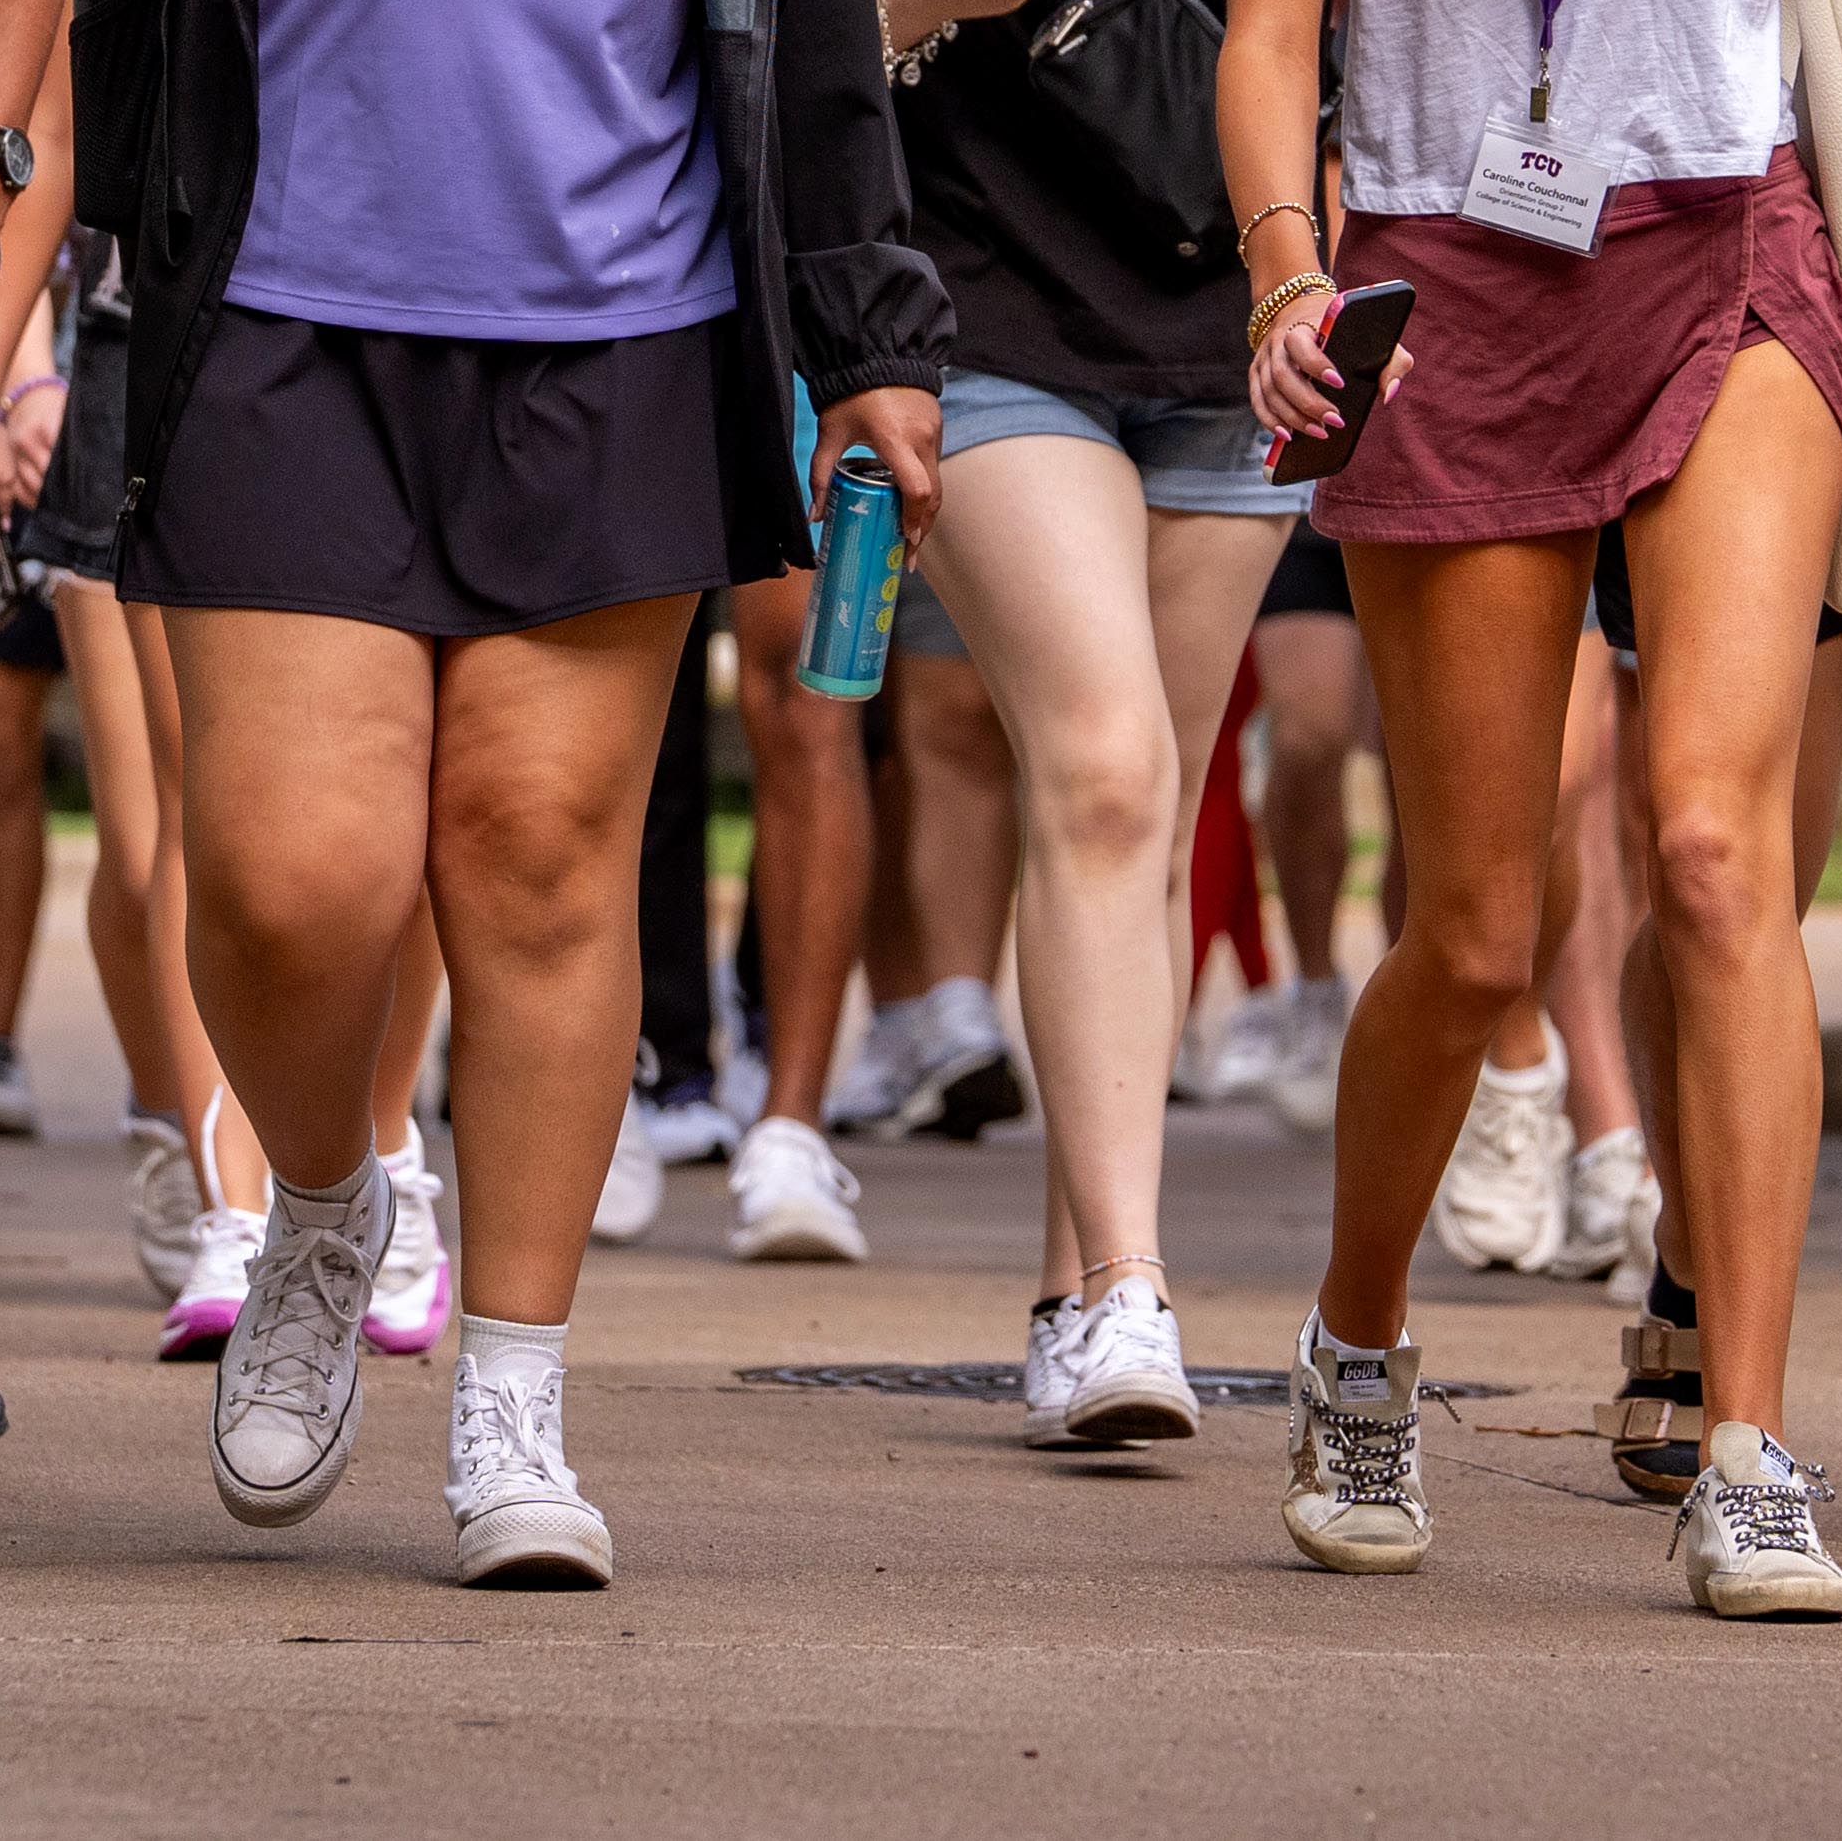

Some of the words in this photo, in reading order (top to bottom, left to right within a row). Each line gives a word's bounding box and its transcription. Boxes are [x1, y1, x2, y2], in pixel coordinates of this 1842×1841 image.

[1520, 151, 1563, 178] TCU
[1482, 168, 1525, 189] Caroline
[1527, 181, 1589, 208] Couchonnal
[1499, 187, 1537, 204] Orientation
[1538, 199, 1560, 211] Group
[1475, 190, 1501, 204] College
[1510, 201, 1535, 214] Science
[1543, 210, 1582, 229] Engineering
[1344, 1362, 1379, 1380] GGDB
